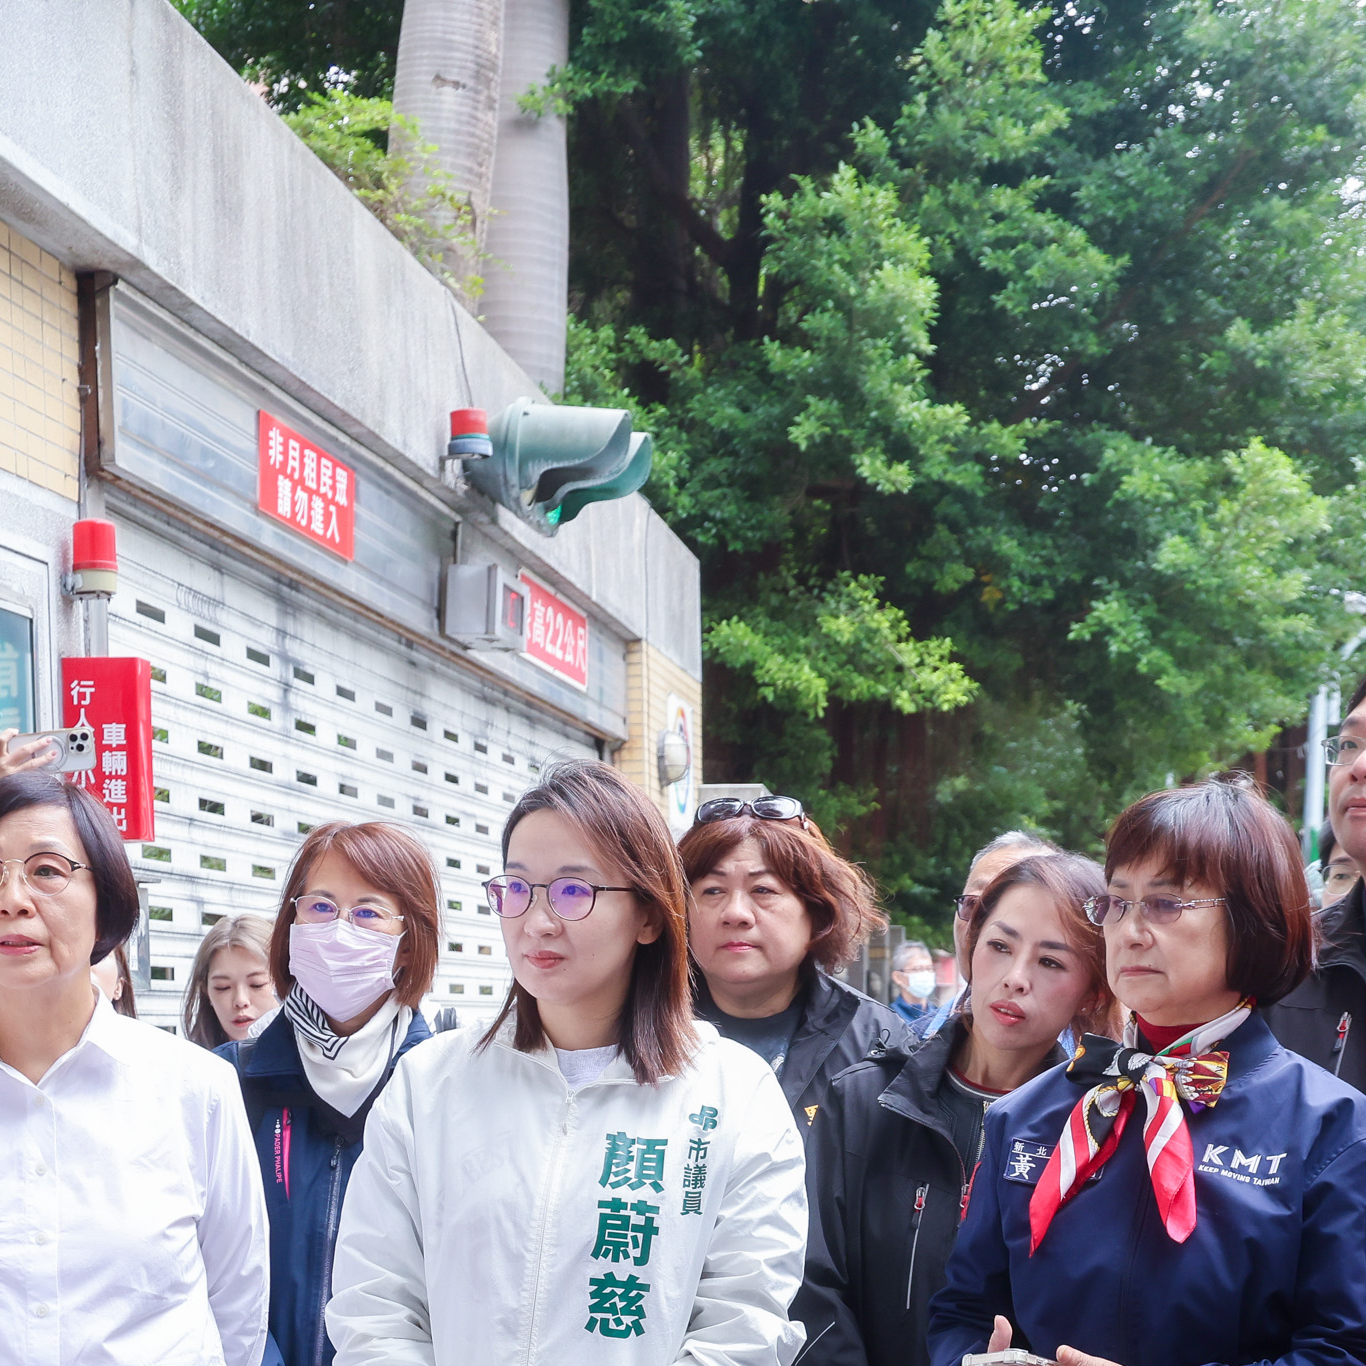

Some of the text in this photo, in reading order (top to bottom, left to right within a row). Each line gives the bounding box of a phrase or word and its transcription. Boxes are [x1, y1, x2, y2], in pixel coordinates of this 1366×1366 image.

[268, 427, 348, 507] 非月租民眾
[277, 474, 340, 544] 請勿進入
[101, 722, 127, 832] 車輛進出
[680, 1138, 711, 1216] 市議員
[1010, 1154, 1036, 1180] 黃
[1198, 1164, 1281, 1187] KEEP MOVING TAIWAN
[1202, 1143, 1288, 1175] KMT
[584, 1131, 669, 1339] 顏蔚慈
